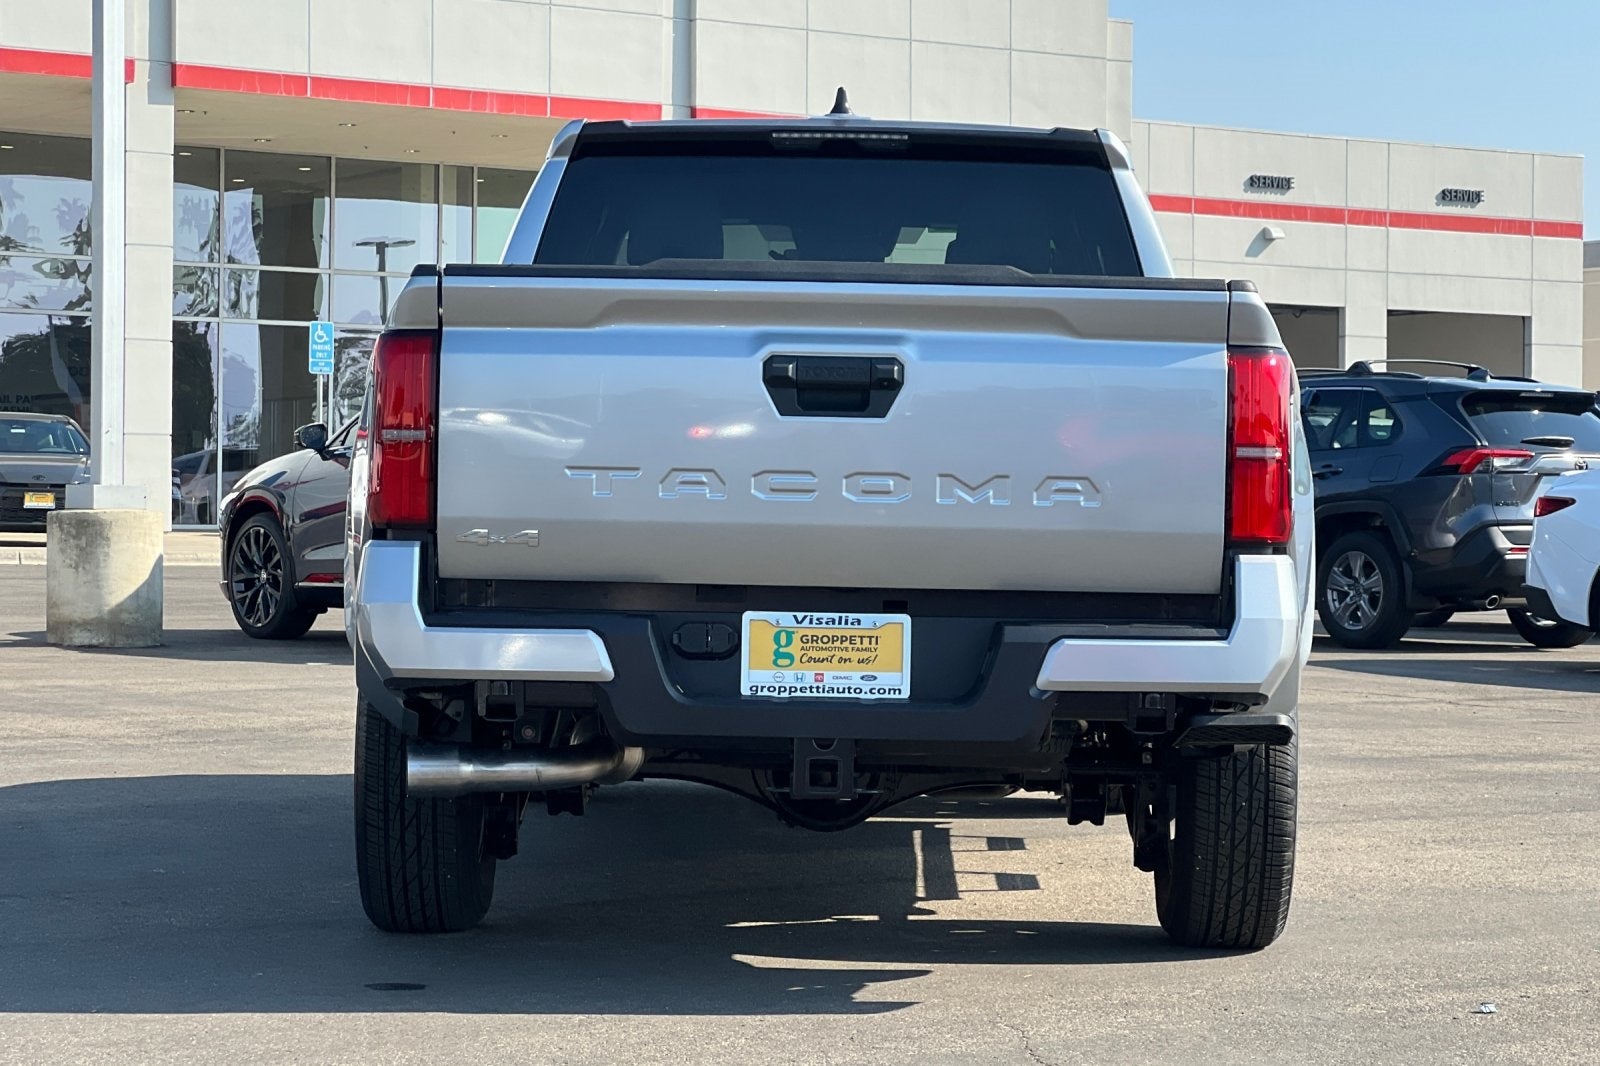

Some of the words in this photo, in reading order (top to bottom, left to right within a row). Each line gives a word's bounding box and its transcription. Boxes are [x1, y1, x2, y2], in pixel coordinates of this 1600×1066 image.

[1249, 174, 1295, 190] SERVICE
[1441, 188, 1485, 203] SERVICE
[564, 465, 1102, 507] TACOMA
[792, 614, 862, 626] Visalia
[800, 634, 879, 646] GROPPETTI
[799, 653, 835, 664] Count
[837, 655, 853, 664] on
[857, 654, 879, 666] us!
[749, 684, 902, 695] groppettiauto.com
